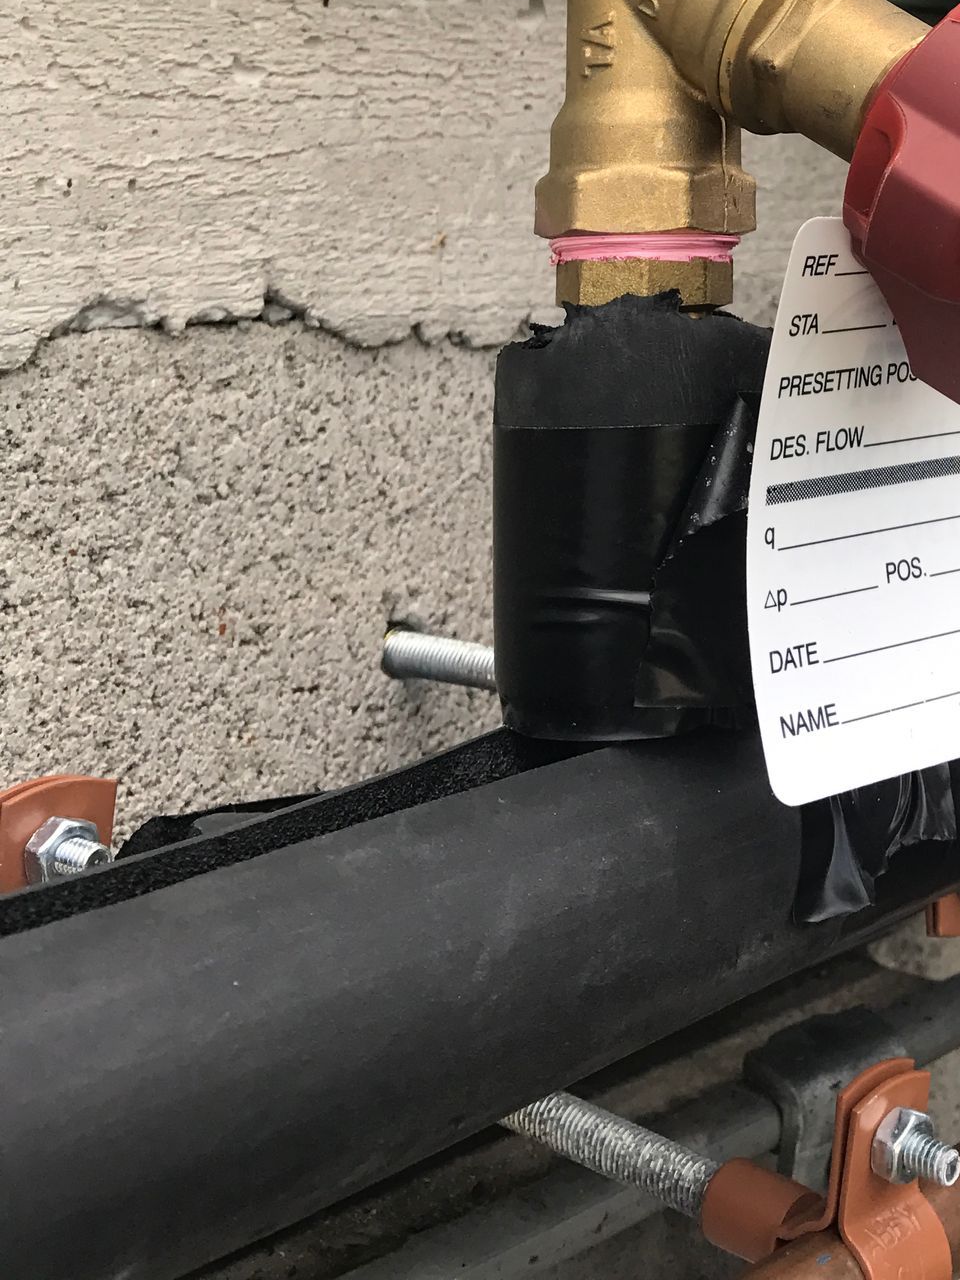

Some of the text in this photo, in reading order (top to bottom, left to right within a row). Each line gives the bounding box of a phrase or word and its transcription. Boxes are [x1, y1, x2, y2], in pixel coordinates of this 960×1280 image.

[802, 253, 839, 277] REF
[788, 313, 820, 337] STA
[778, 363, 882, 399] PRESETTING
[770, 425, 865, 461] DES. FLOW
[764, 526, 776, 550] q
[885, 556, 928, 584] POS.
[769, 641, 820, 674] DATE
[779, 703, 840, 739] NAME
